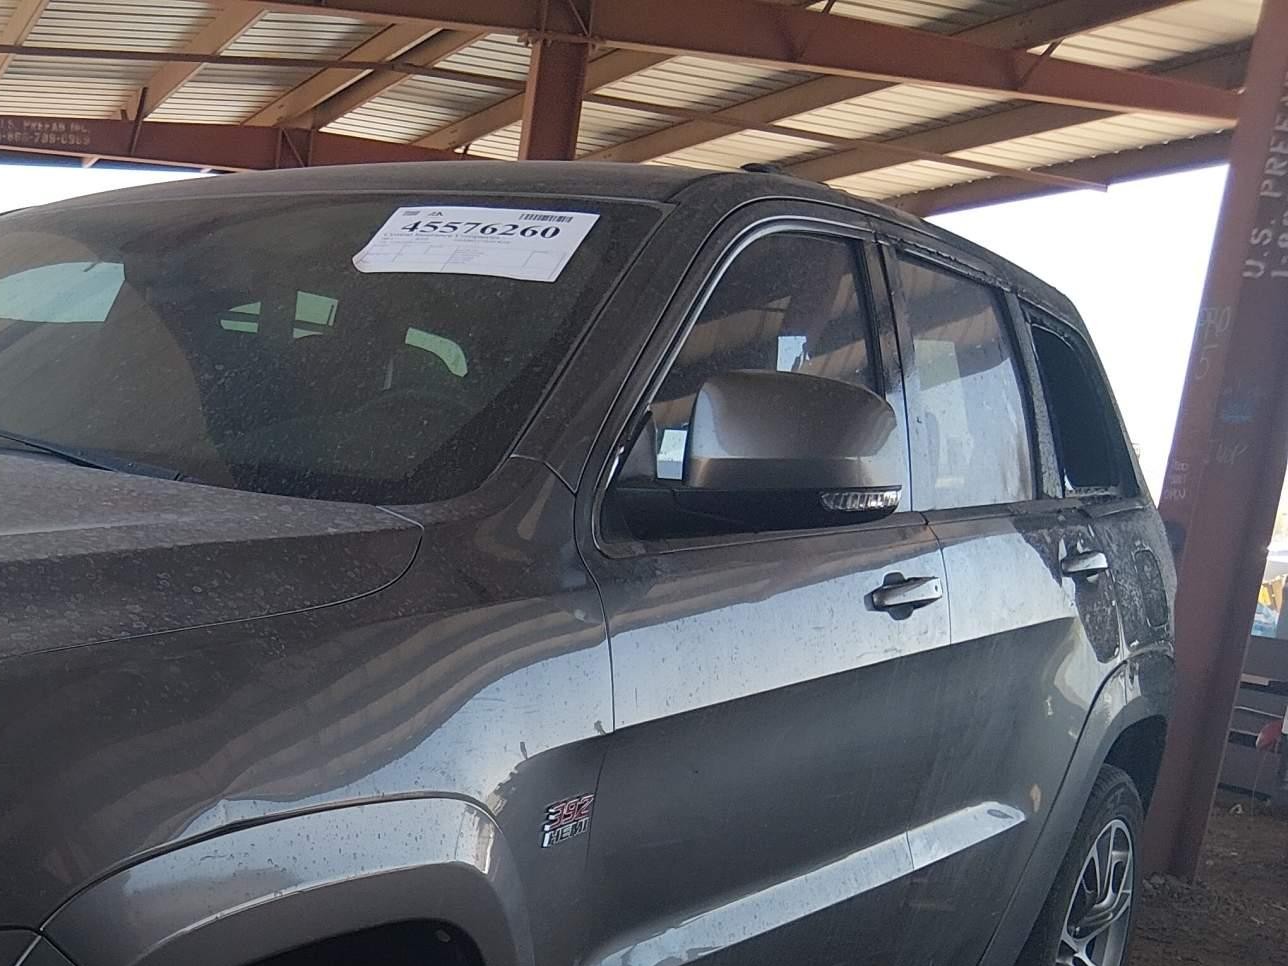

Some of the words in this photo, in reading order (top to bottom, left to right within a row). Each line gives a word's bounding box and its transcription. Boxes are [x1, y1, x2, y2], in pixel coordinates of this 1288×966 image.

[400, 220, 561, 239] 45576260
[1242, 219, 1277, 279] U.S.
[544, 794, 594, 831] 392
[542, 817, 590, 847] HEMI
